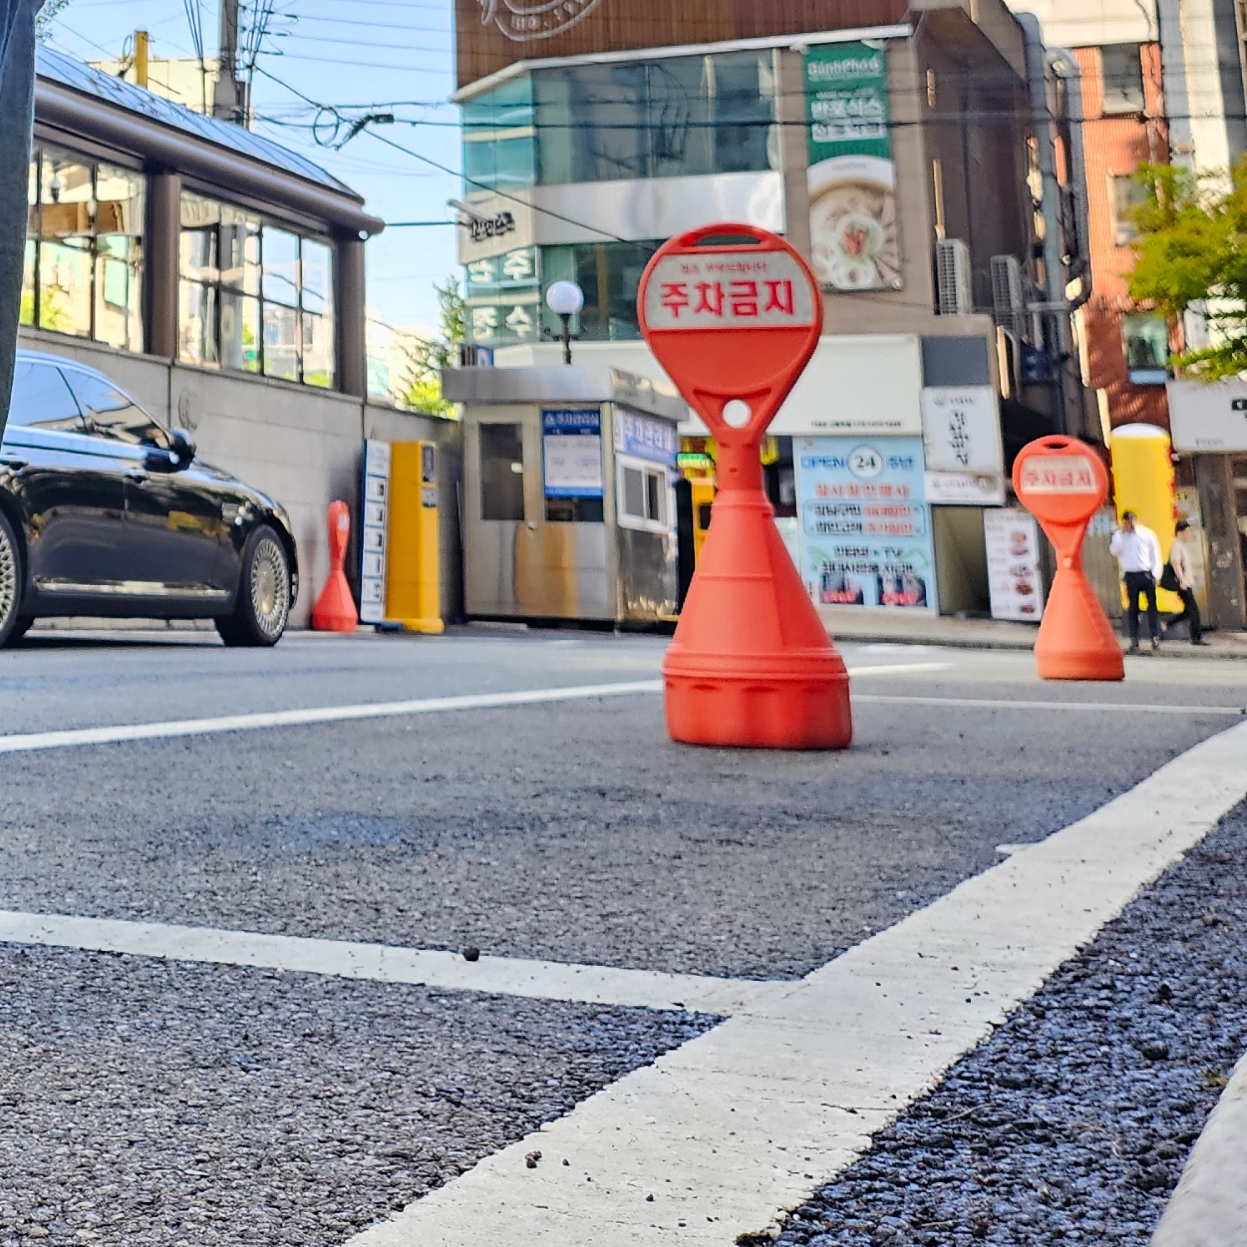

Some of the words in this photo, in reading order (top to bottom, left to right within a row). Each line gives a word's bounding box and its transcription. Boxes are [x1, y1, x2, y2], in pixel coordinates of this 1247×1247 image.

[660, 279, 795, 318] 주차금지
[800, 456, 845, 468] OPEN
[855, 455, 876, 469] 24
[1027, 469, 1091, 486] 주차금지
